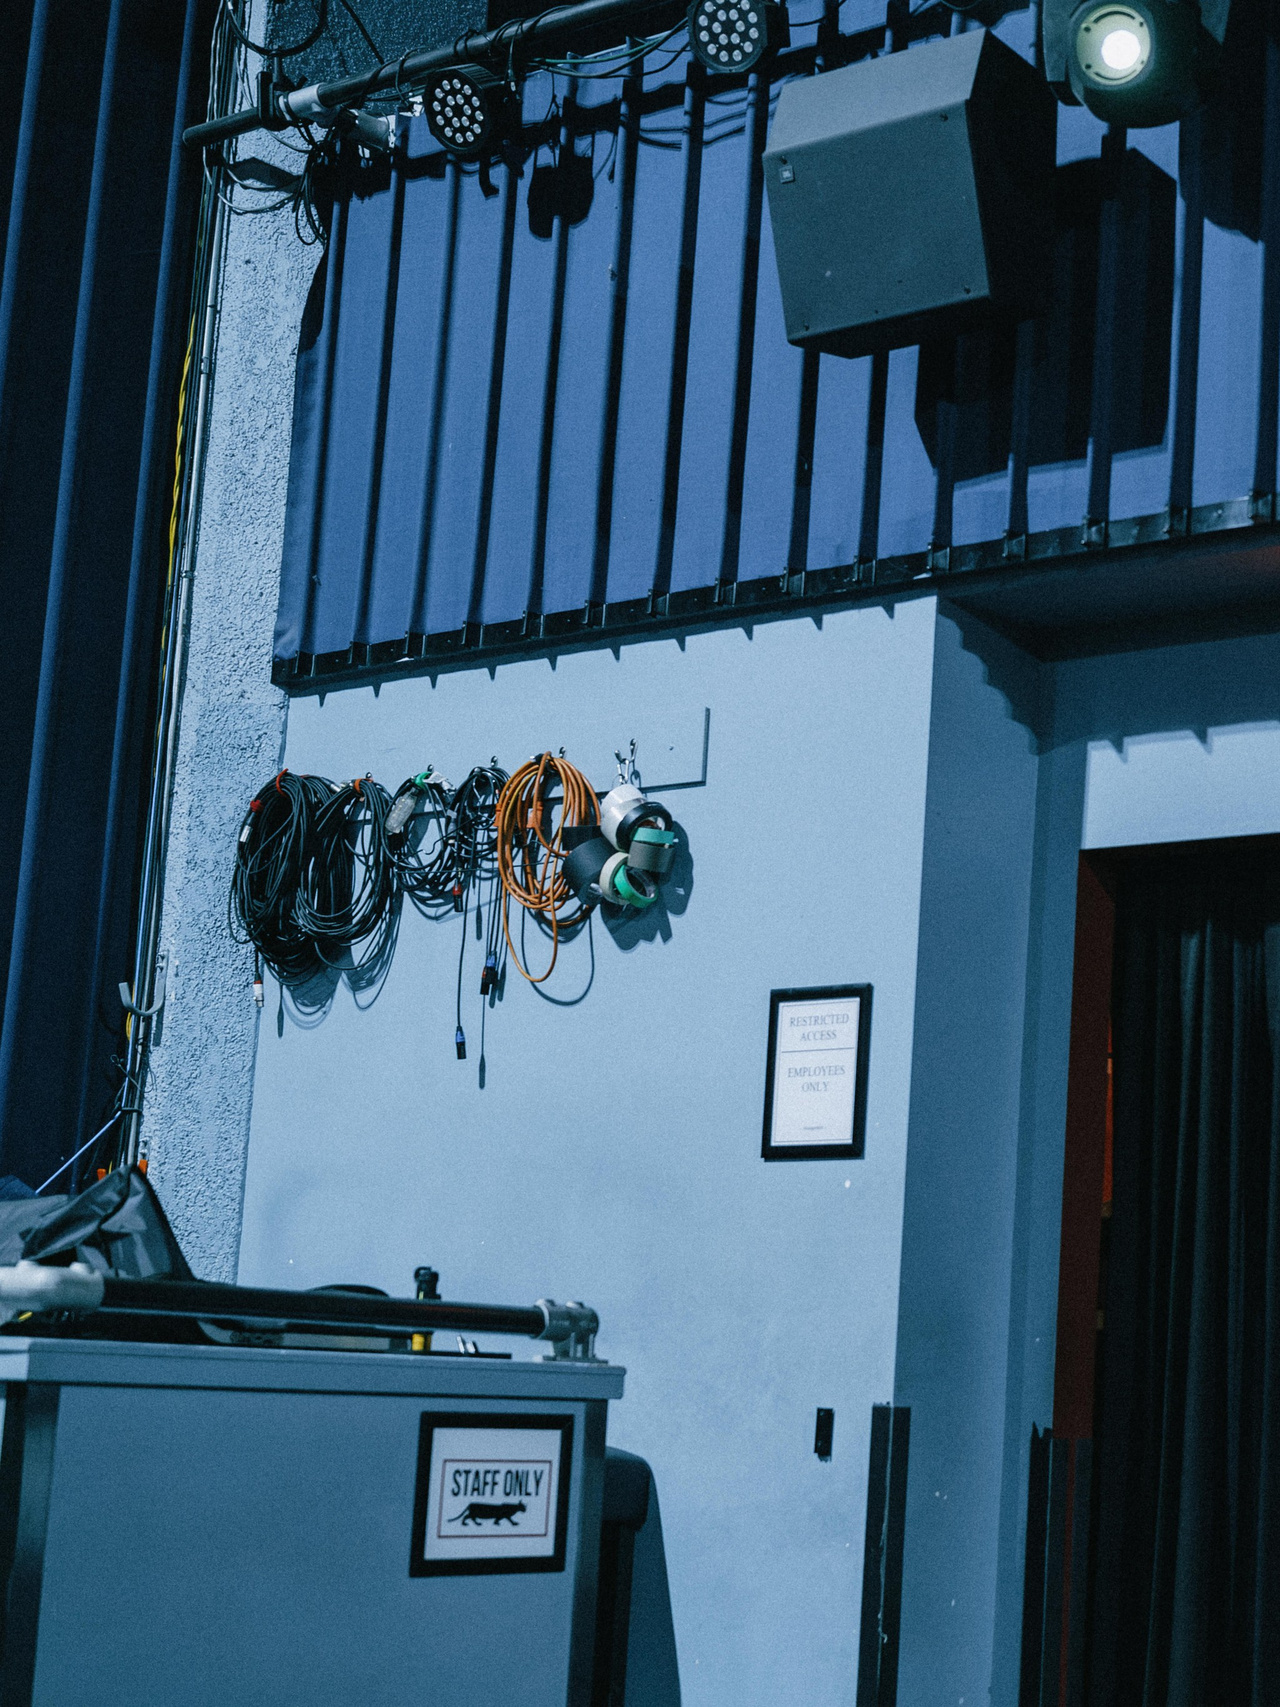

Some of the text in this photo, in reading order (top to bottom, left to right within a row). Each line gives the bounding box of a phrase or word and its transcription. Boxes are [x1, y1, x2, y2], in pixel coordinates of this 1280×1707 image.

[789, 1013, 849, 1028] RESTRICTED
[800, 1030, 837, 1042] ACCESS
[787, 1065, 846, 1078] EMPLOYEES
[801, 1081, 830, 1093] ONLY
[452, 1469, 544, 1497] STAFF ONLY
